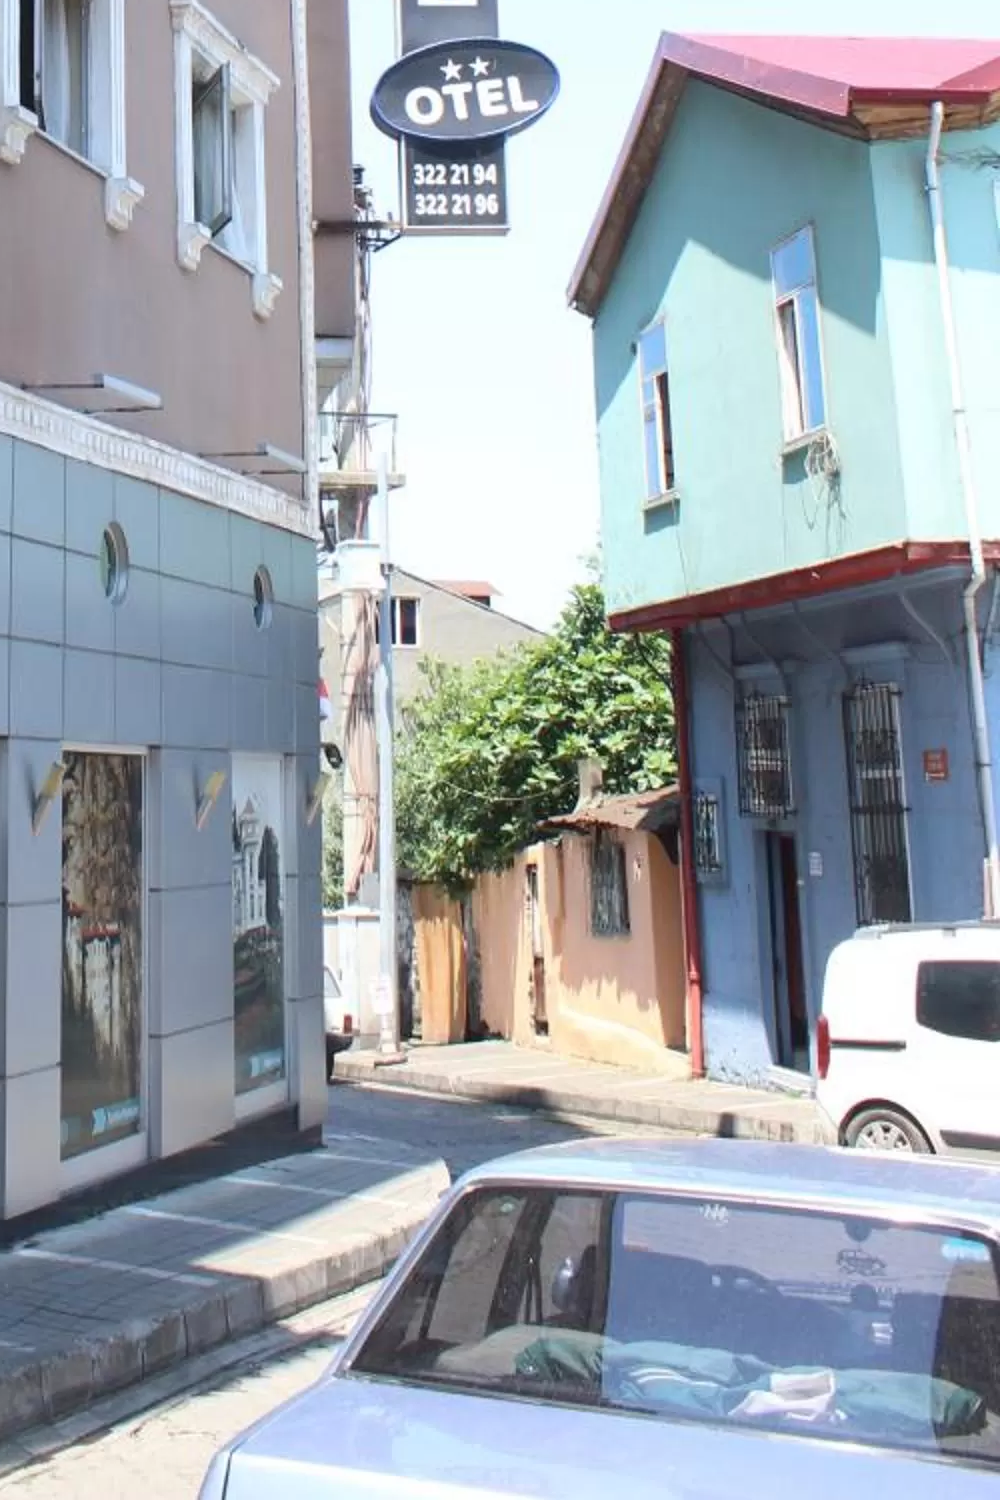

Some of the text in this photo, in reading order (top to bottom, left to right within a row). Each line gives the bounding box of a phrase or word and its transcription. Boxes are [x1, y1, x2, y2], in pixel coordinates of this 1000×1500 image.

[404, 75, 540, 126] OTEL
[413, 163, 498, 186] 322 21 94
[415, 193, 499, 216] 322 21 96
